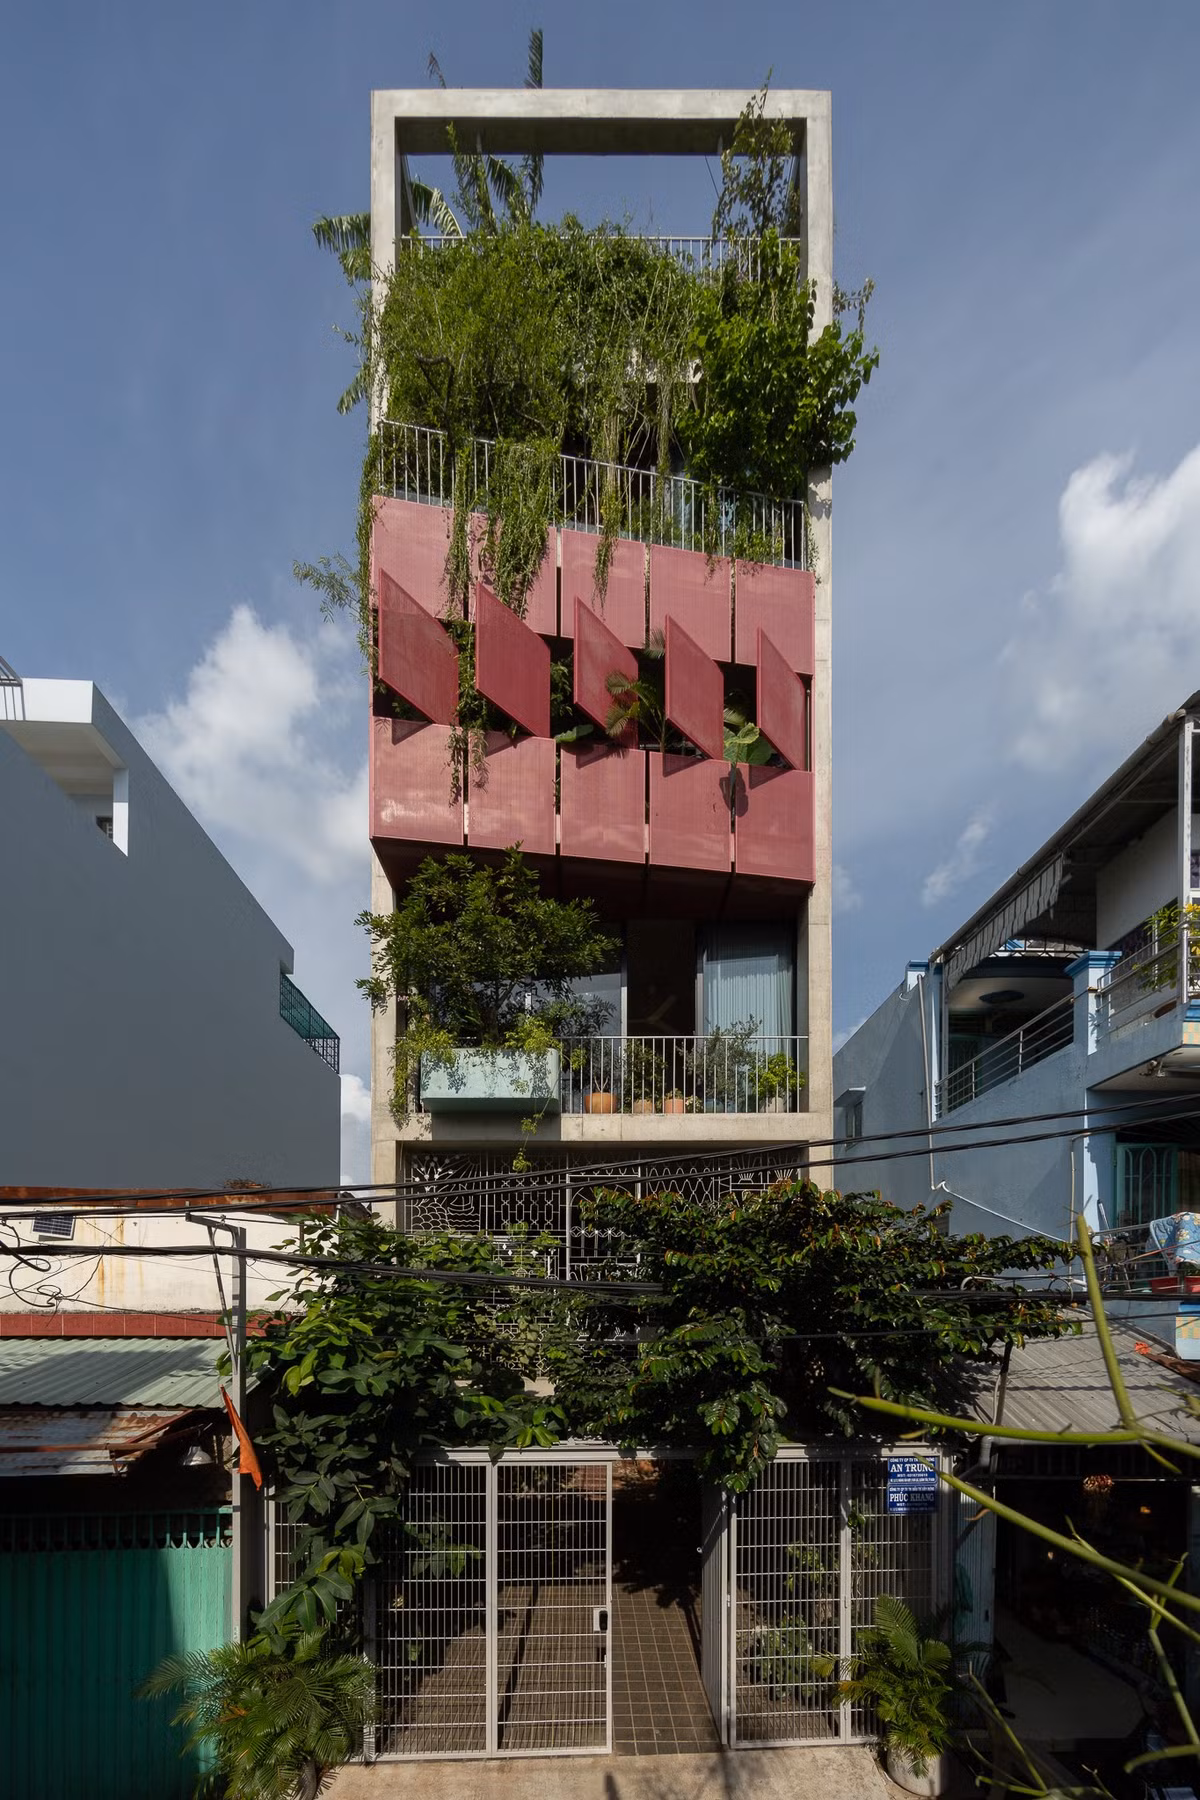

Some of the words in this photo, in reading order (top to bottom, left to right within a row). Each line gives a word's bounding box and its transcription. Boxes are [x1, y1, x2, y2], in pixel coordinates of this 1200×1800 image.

[890, 1464, 903, 1472] AN
[890, 1491, 908, 1502] PHÚC
[910, 1494, 934, 1502] KHANG
